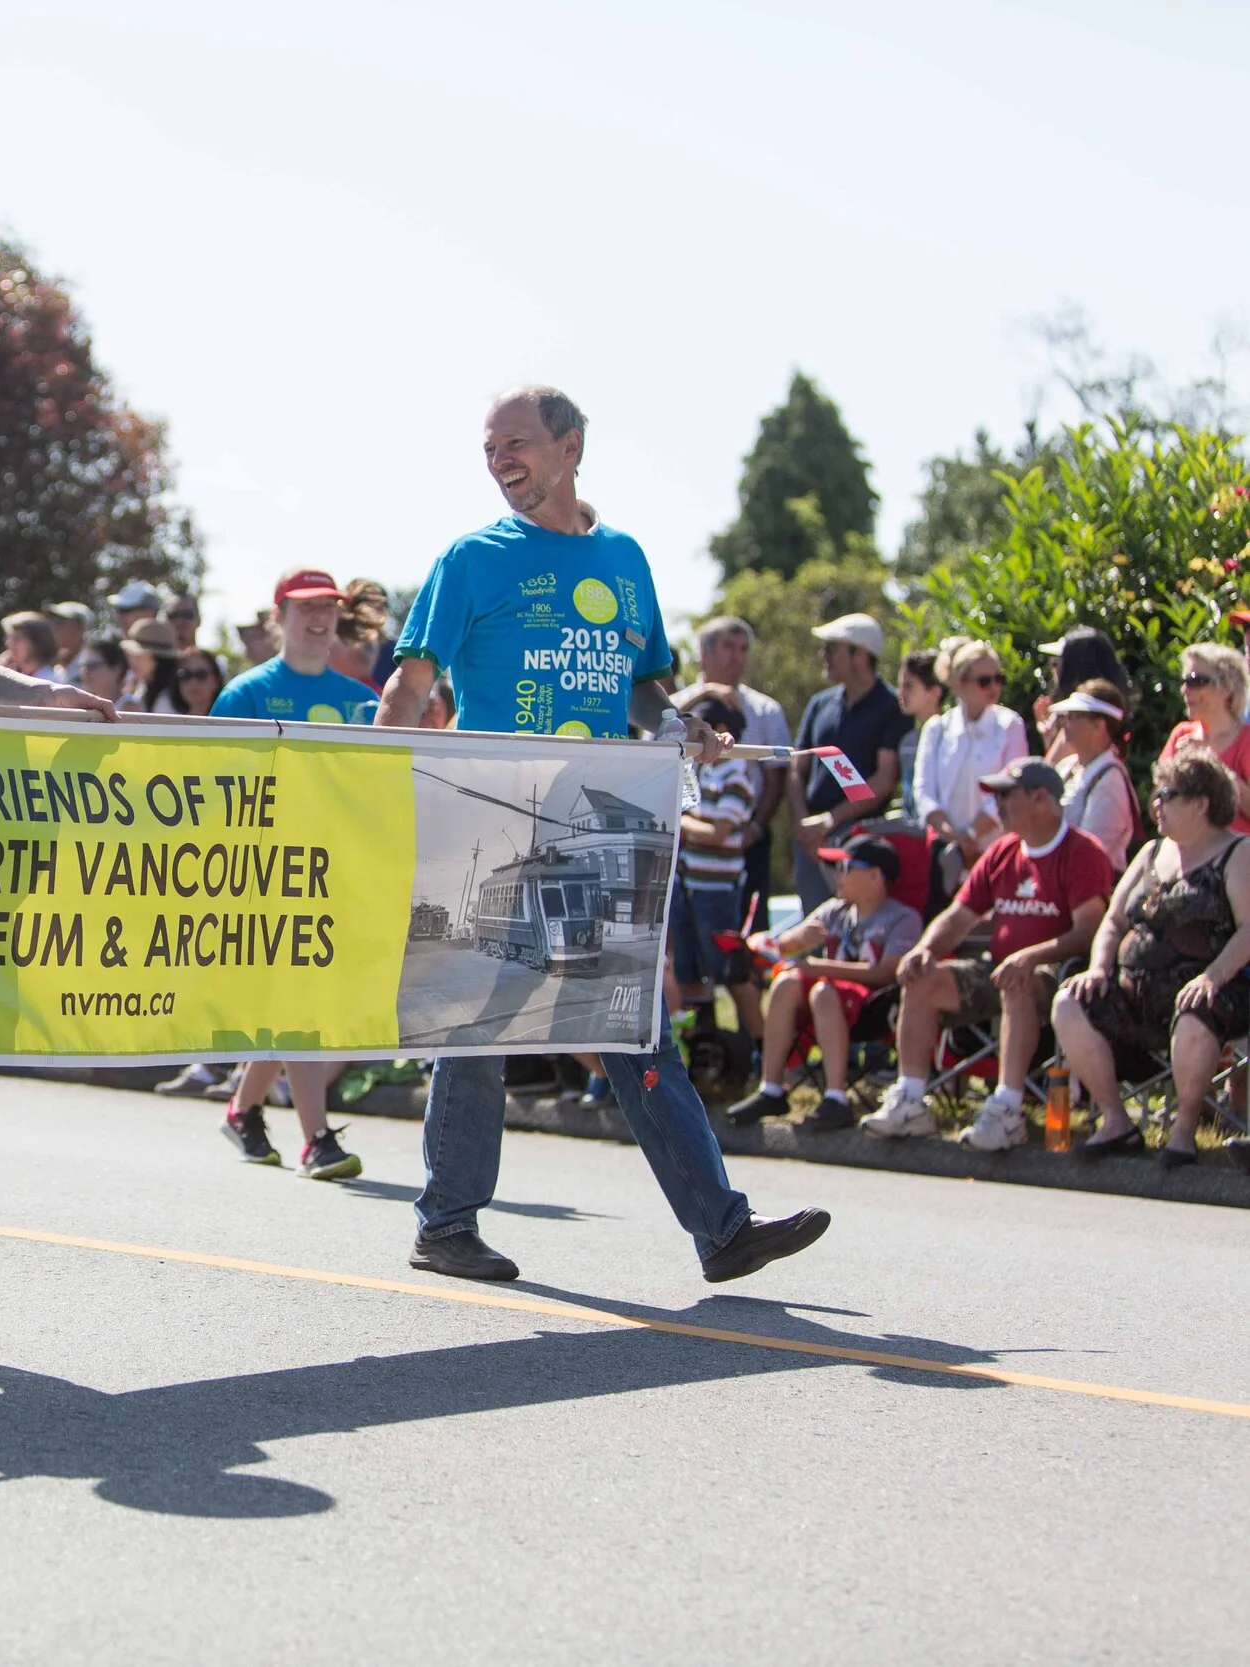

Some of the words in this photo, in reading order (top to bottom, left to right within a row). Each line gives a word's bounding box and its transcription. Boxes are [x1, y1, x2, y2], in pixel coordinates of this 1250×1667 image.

[519, 573, 557, 589] 1863
[522, 587, 557, 596] Moodyville
[531, 604, 552, 612] 1906
[626, 587, 640, 626] 1900
[560, 627, 619, 651] 2019
[524, 650, 571, 670] NEW
[560, 670, 619, 694] OPENS
[583, 697, 601, 707] 1977
[536, 704, 546, 731] Victory
[145, 773, 206, 827] OF
[214, 775, 277, 828] THE
[75, 841, 330, 899] VANCOUVER
[994, 896, 1062, 917] CANADA
[100, 915, 129, 968] &
[143, 912, 335, 968] ARCHIVES
[61, 991, 176, 1017] nvma.ca
